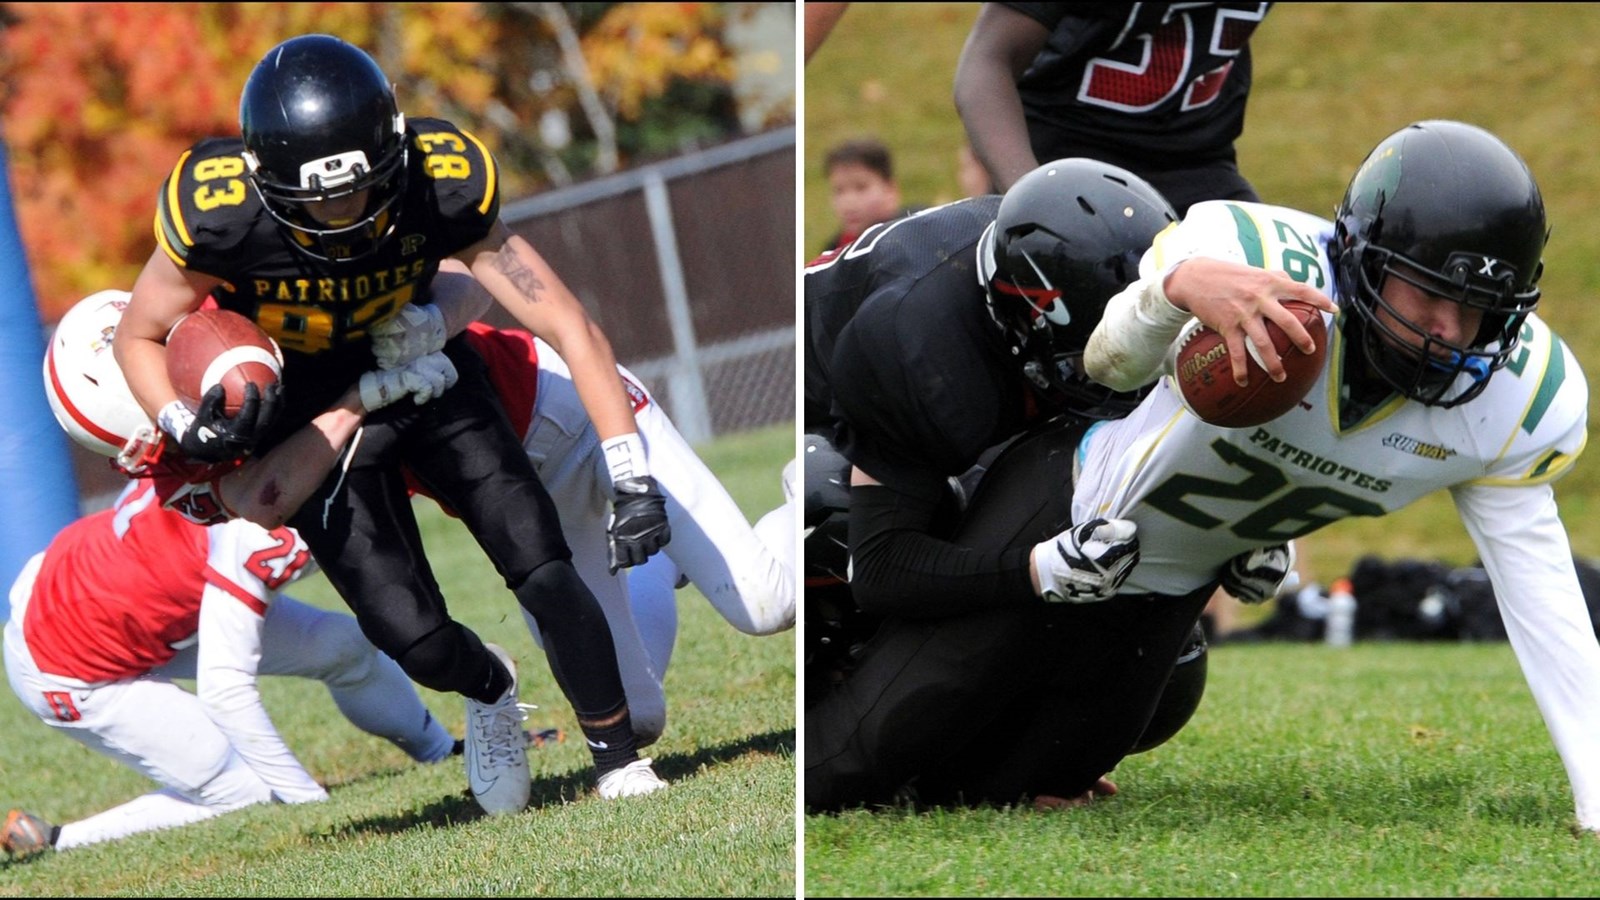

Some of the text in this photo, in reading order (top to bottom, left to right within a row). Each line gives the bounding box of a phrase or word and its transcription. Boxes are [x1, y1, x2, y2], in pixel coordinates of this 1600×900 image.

[415, 131, 470, 180] 83
[193, 155, 246, 212] 83
[254, 258, 426, 302] PATRIOTES
[1272, 218, 1325, 289] 26
[1181, 342, 1228, 384] Wilson
[1249, 427, 1393, 493] PATRIOTES
[1382, 432, 1457, 461] SUBWAY
[1142, 437, 1387, 541] 26
